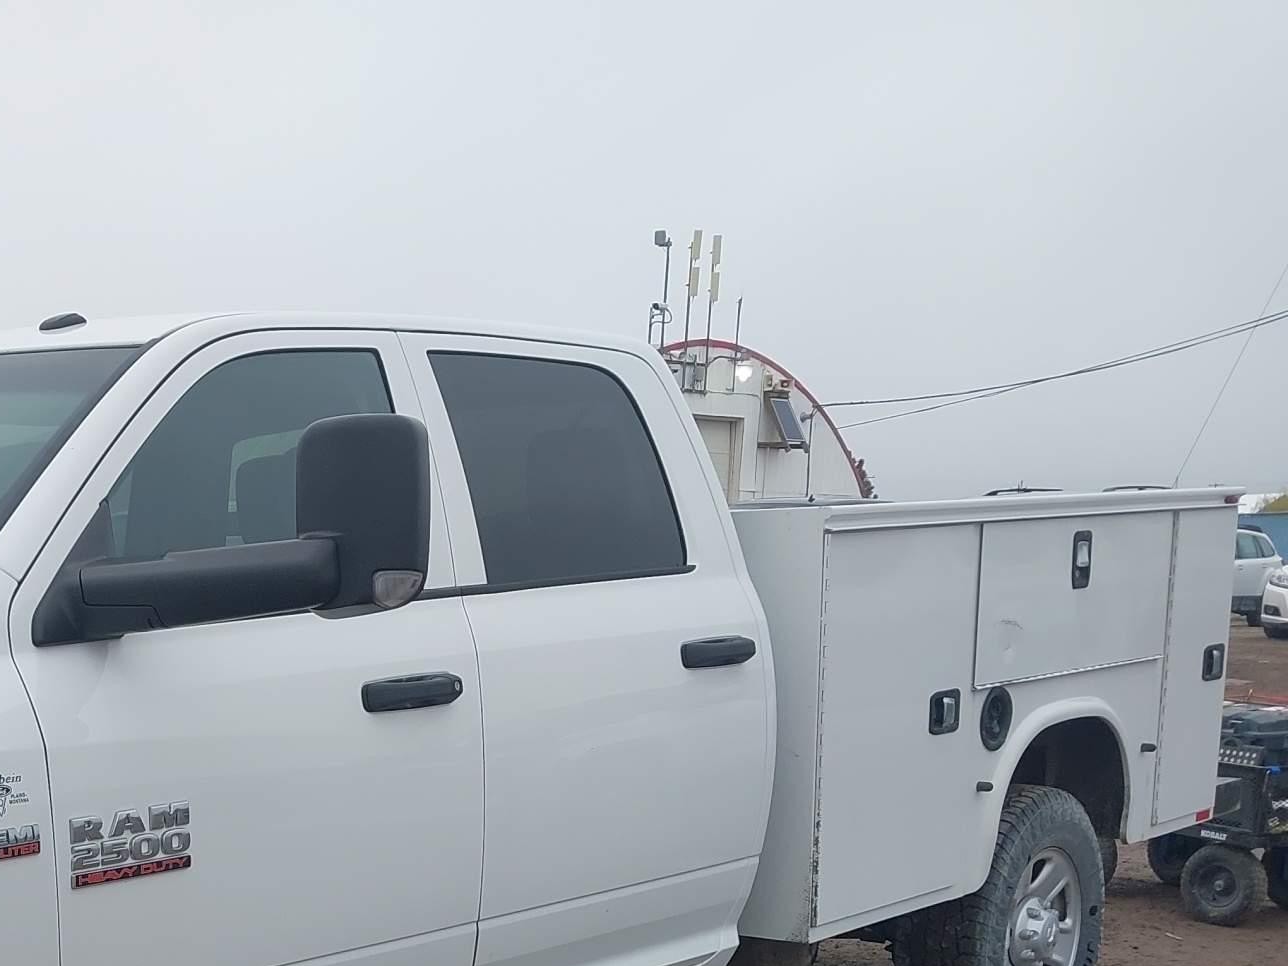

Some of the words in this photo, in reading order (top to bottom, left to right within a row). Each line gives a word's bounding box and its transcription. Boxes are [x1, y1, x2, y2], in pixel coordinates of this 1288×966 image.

[69, 800, 190, 845] RAM
[1201, 830, 1227, 840] KOBALT
[0, 843, 40, 860] LITER
[71, 829, 191, 872] 2500
[79, 865, 137, 886] HEAVY
[140, 856, 187, 874] DUTY
